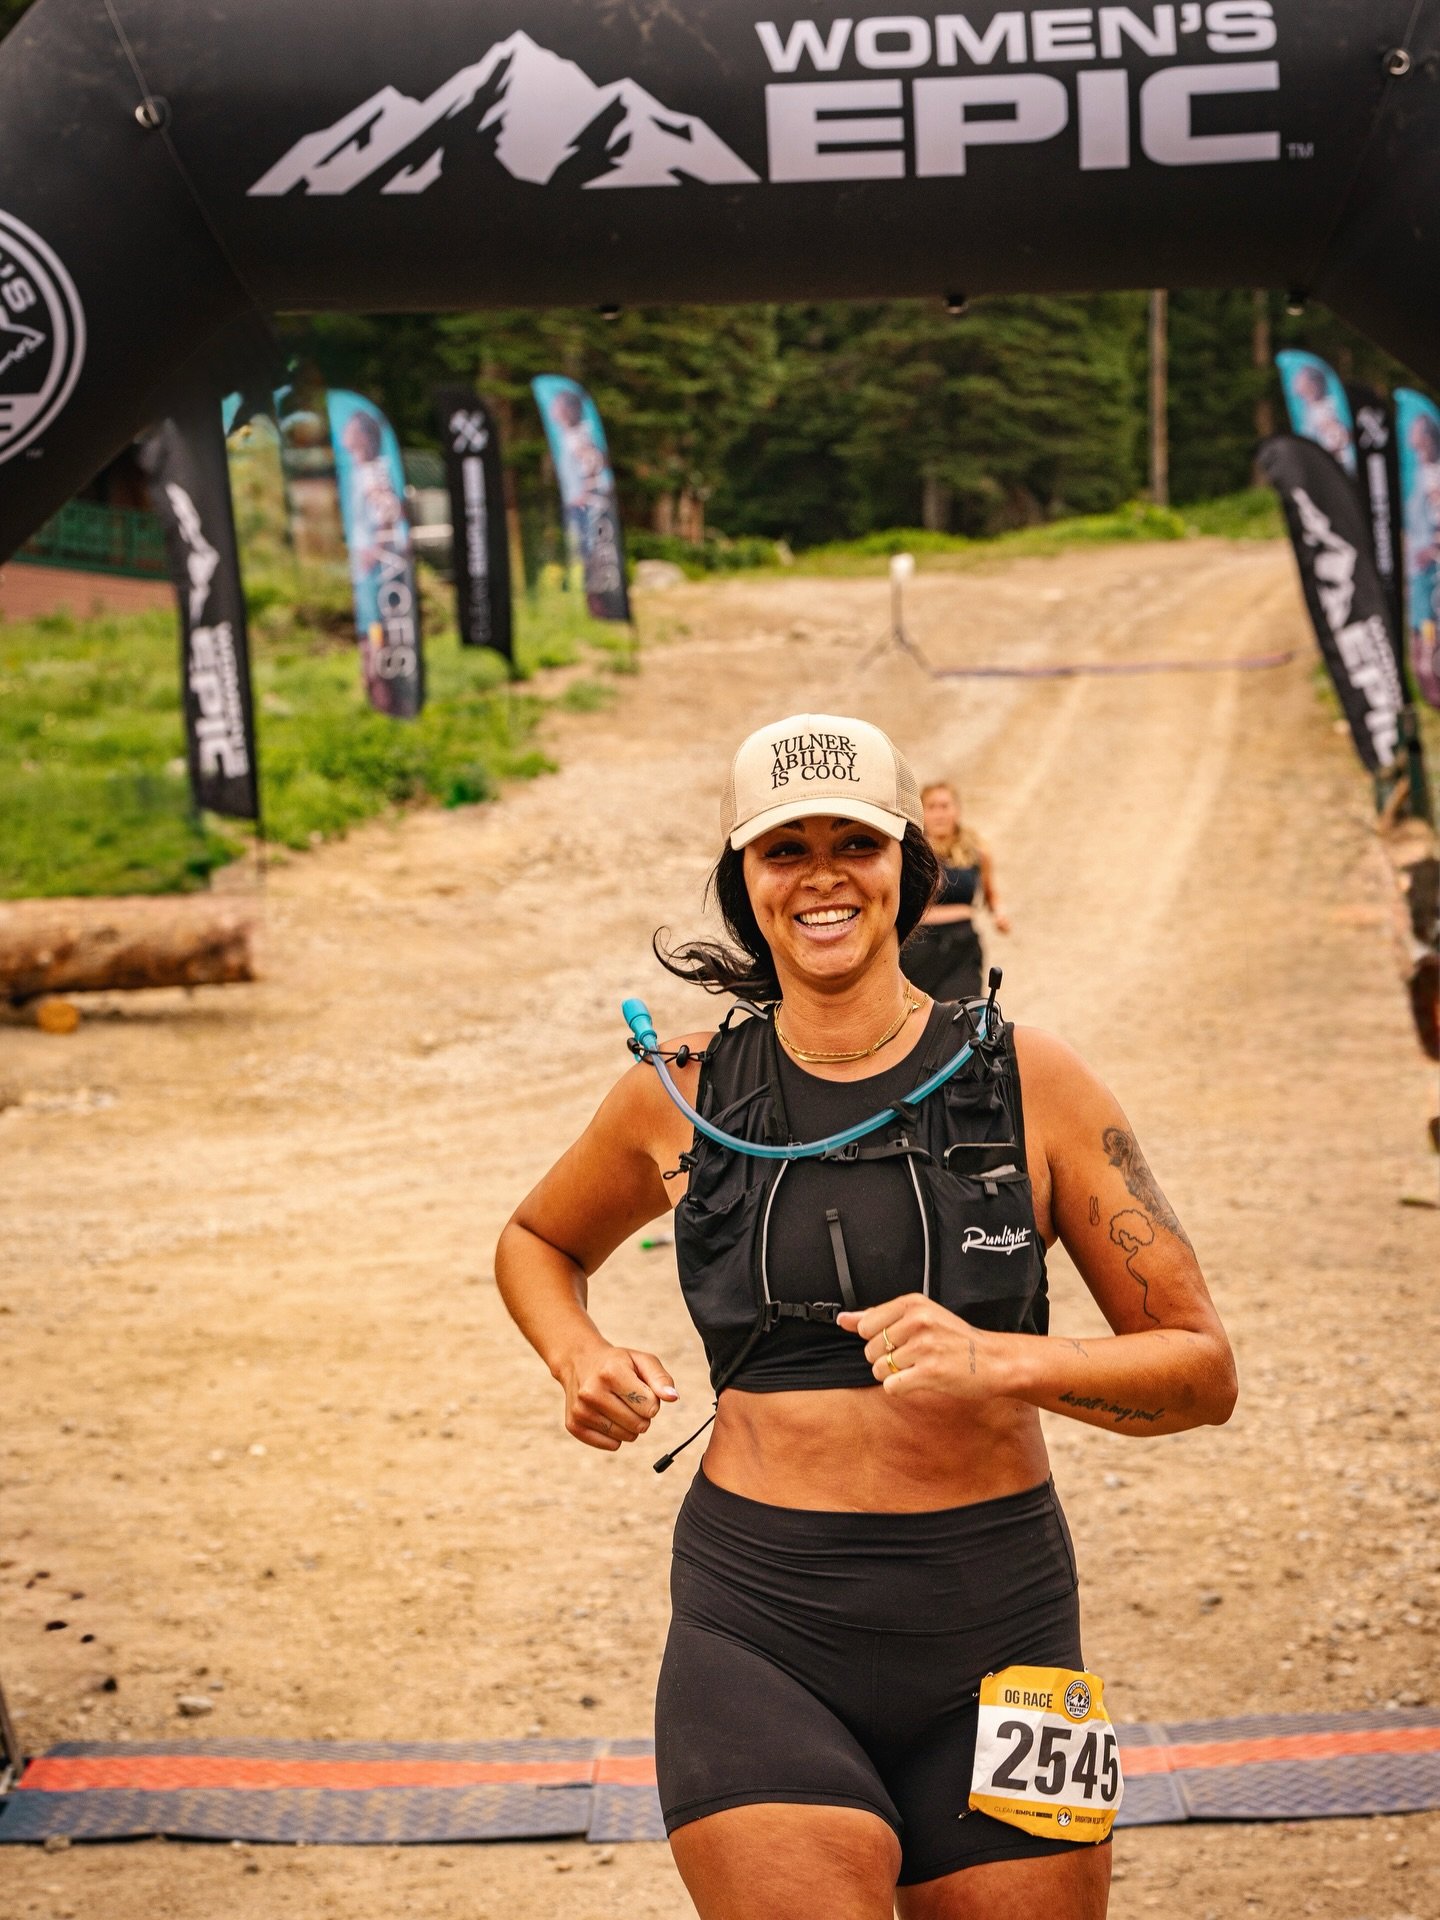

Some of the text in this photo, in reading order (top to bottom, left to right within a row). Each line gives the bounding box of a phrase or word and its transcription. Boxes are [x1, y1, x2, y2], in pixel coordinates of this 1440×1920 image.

[756, 0, 1277, 72] WOMEN'S
[765, 61, 1280, 183] EPIC
[771, 733, 857, 757] VULNER-
[770, 750, 858, 775] ABILITY
[771, 764, 861, 790] IS COOL
[961, 1225, 1032, 1256] Runlight
[1004, 1689, 1054, 1709] OG RACE
[991, 1720, 1119, 1803] 2545
